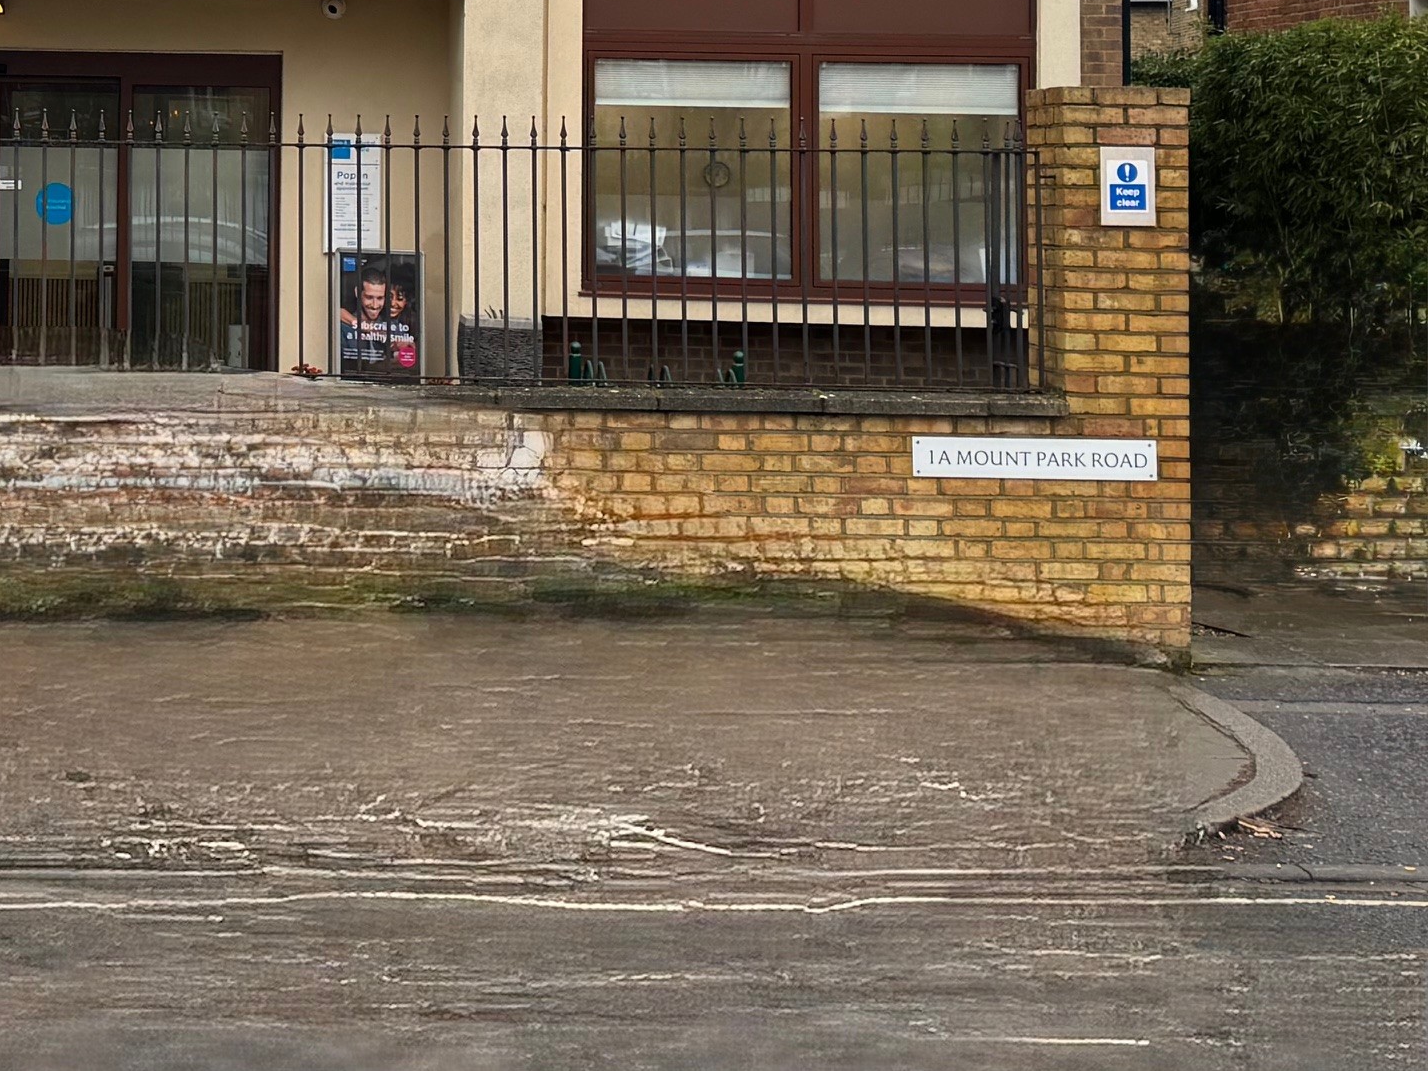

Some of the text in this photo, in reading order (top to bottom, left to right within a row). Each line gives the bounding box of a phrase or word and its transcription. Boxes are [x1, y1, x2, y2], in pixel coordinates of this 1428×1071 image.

[337, 171, 356, 180] Pop
[1116, 187, 1140, 197] Keep
[1116, 198, 1140, 207] clear
[399, 323, 409, 332] to
[390, 333, 415, 343] smile
[929, 449, 1148, 468] 1A MOUNT PARK ROAD
